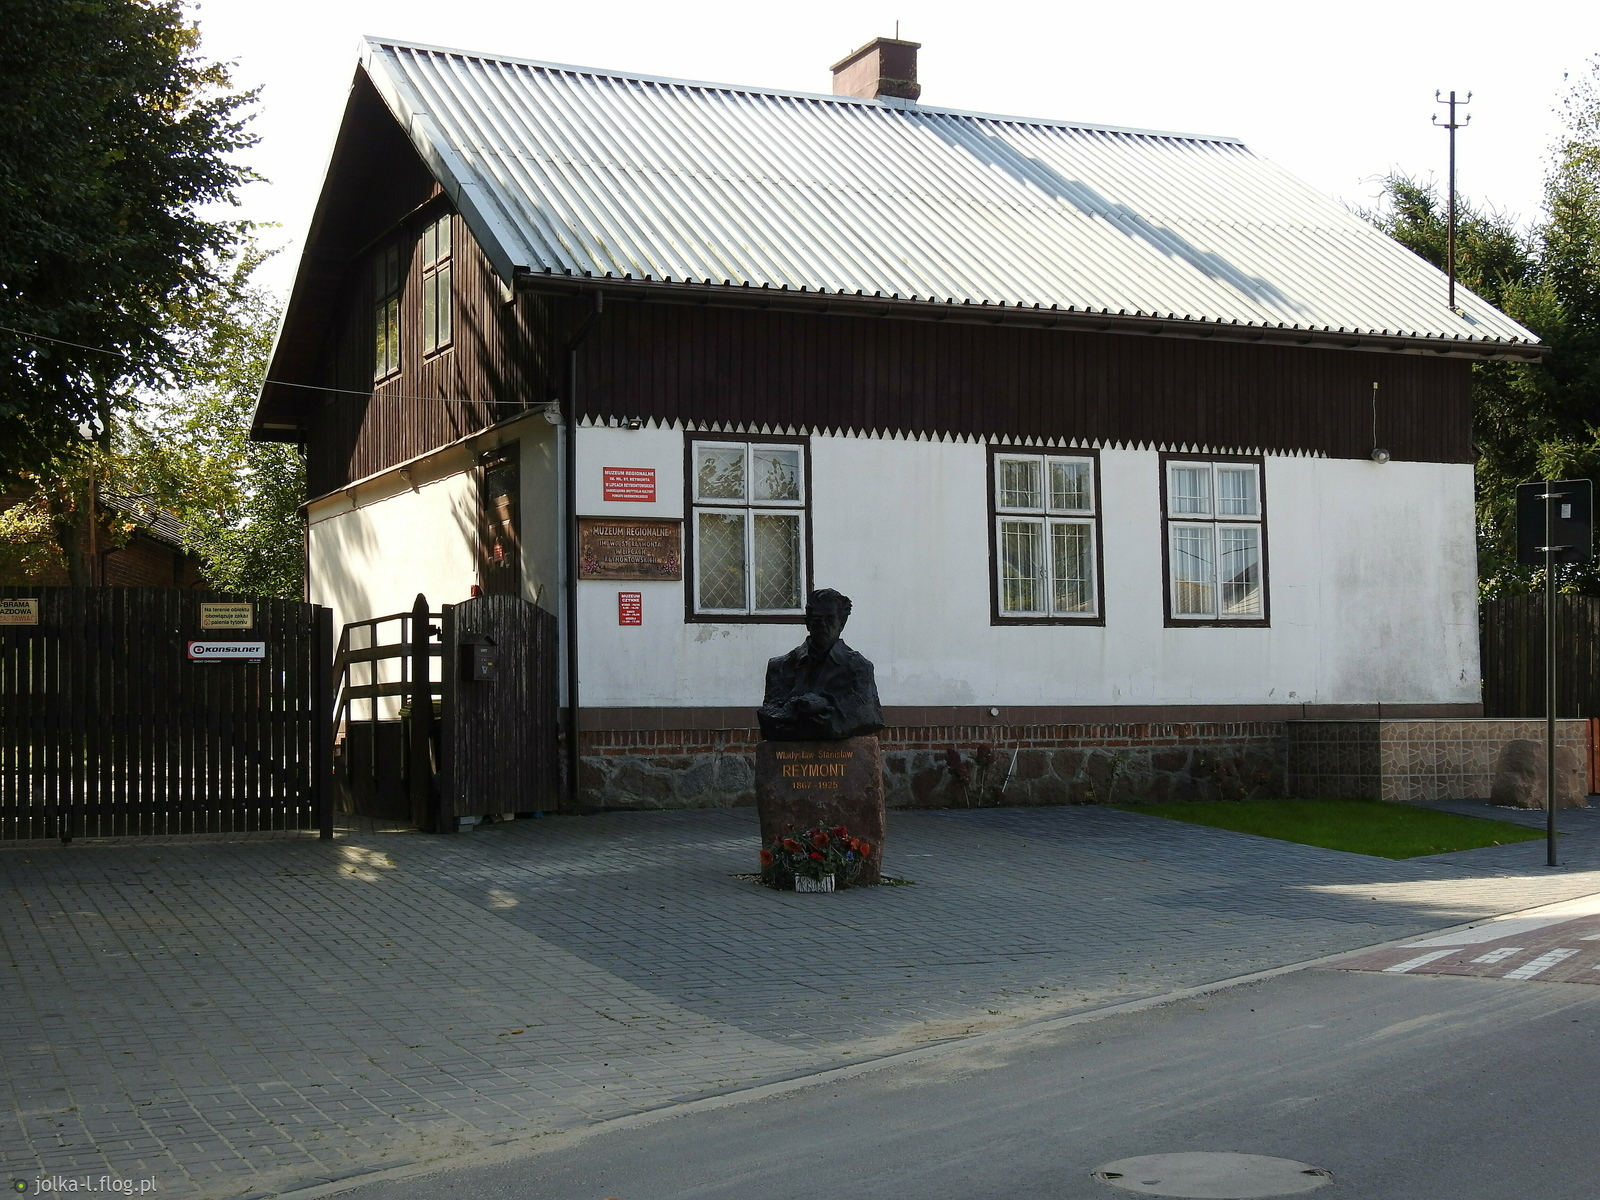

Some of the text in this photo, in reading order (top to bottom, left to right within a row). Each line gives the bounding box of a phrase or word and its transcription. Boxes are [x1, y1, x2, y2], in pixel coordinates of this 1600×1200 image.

[593, 526, 669, 537] MUZEUM REGIONALNE
[782, 763, 847, 777] REYMONT
[792, 781, 812, 789] 1867
[818, 781, 838, 789] 1925
